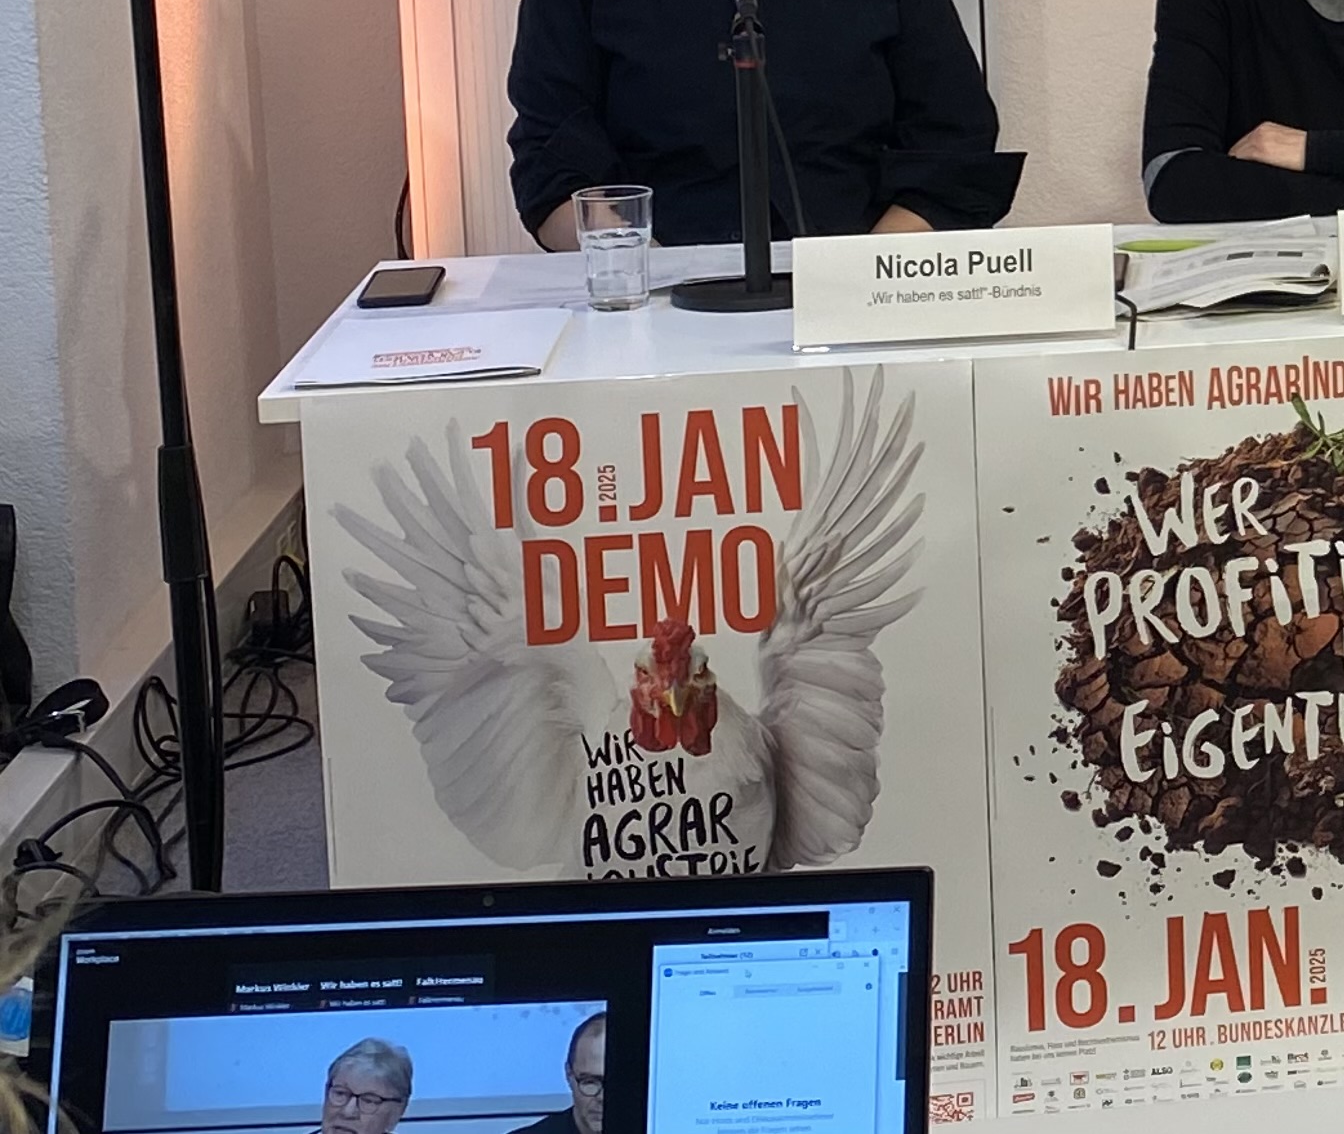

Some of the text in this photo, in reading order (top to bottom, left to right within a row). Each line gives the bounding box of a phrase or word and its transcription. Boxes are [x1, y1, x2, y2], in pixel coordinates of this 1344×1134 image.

[875, 248, 1033, 280] Nicola Puell
[896, 288, 935, 304] haben
[939, 290, 954, 302] es
[1113, 370, 1195, 410] HABEN
[600, 463, 617, 502] 2025
[1130, 472, 1270, 557] WER
[521, 524, 778, 646] DEMO
[587, 757, 687, 809] HABEN
[583, 792, 739, 867] AGRAR
[947, 970, 983, 993] UHR
[1008, 923, 1136, 1033] 18.
[1309, 946, 1327, 985] 2025
[932, 1021, 985, 1047] ERLIN
[1148, 1030, 1167, 1051] 12
[710, 1097, 822, 1111] Keine offenen Fragen
